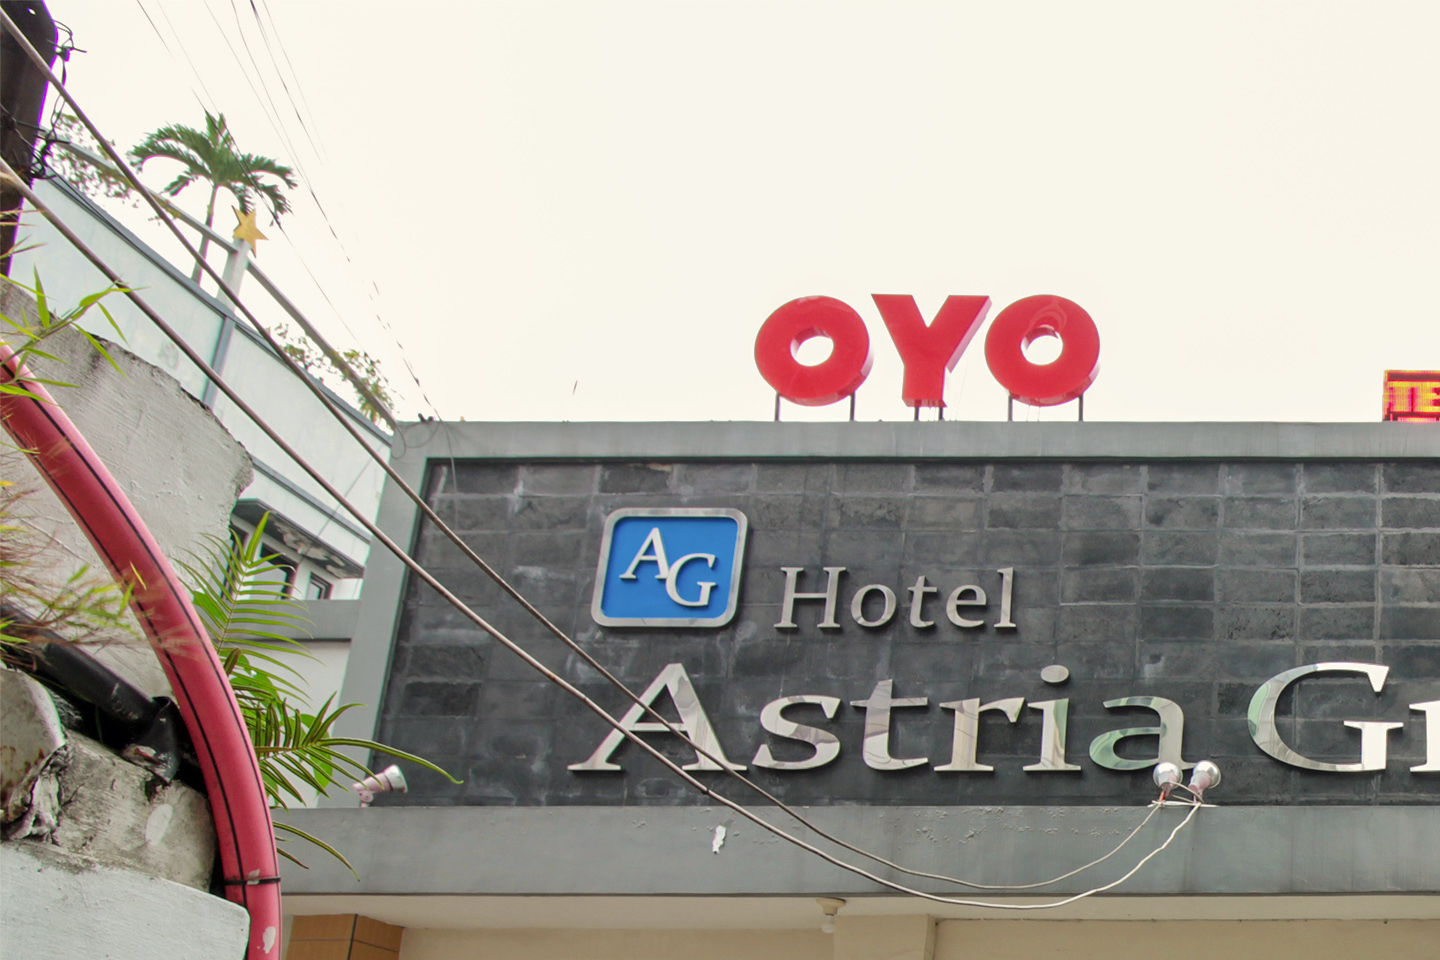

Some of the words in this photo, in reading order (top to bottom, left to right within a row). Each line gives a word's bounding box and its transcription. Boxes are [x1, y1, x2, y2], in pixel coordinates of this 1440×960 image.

[754, 294, 1102, 408] OYO
[620, 527, 717, 607] AG
[774, 566, 1017, 629] Hotel
[567, 662, 1200, 773] Astria
